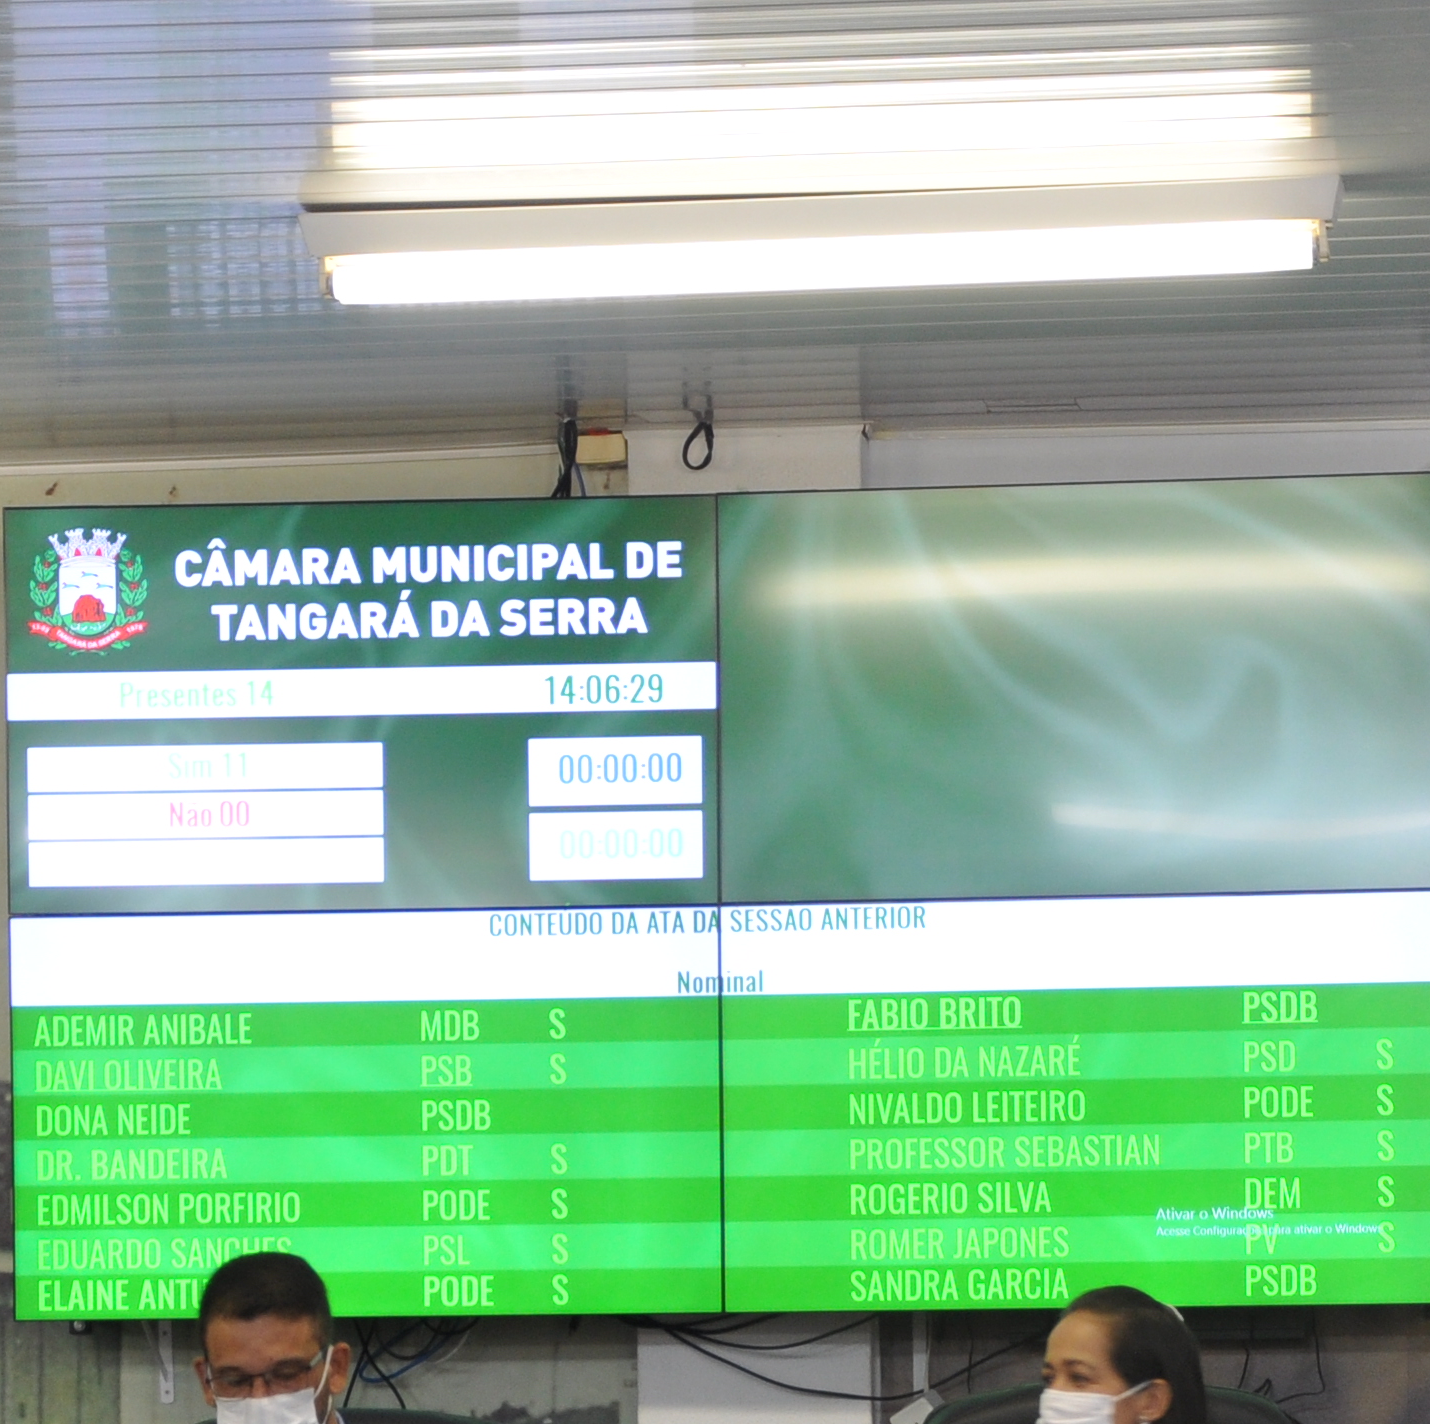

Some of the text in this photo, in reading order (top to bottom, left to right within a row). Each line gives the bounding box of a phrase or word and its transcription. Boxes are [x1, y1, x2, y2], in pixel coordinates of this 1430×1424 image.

[174, 537, 683, 588] CÂMARA MUNICIPAL DE
[211, 590, 648, 642] TANGARÁ DA SERRA
[120, 680, 274, 709] Presentes 14
[545, 674, 664, 706] 14:06:29
[169, 752, 247, 778] Sim 11
[558, 752, 683, 785] 00:00:00
[220, 800, 249, 827] 00
[559, 828, 683, 861] 00:00:00
[612, 911, 639, 935] DA
[647, 910, 684, 934] ATA
[693, 910, 720, 934] DA
[821, 906, 926, 931] ANTERIOR
[677, 970, 764, 994] Nominal
[847, 995, 1022, 1030] FABIO BRITO
[1243, 990, 1318, 1024] PSDB
[34, 1012, 252, 1047] ADEMIR ANIBALE
[420, 1009, 480, 1042] MDB
[549, 1008, 566, 1040] S
[549, 1053, 567, 1085] S
[849, 1035, 1081, 1080] HÉLIO DA NAZARÉ
[1243, 1041, 1297, 1073] PSD
[1376, 1038, 1393, 1070] S
[35, 1057, 222, 1092] DAVI OLIVEIRA
[421, 1055, 473, 1087] PSB
[421, 1099, 492, 1132] PSDB
[849, 1089, 1086, 1126] NIVALDO LEITEIRO
[1244, 1085, 1314, 1119] PODE
[1376, 1084, 1394, 1117] S
[35, 1103, 191, 1137] DONA NEIDE
[422, 1144, 474, 1177] PDT
[550, 1143, 568, 1175] S
[850, 1133, 1161, 1170] PROFESSOR SEBASTIAN
[1244, 1131, 1294, 1164] PTB
[1377, 1130, 1394, 1162] S
[36, 1147, 228, 1182] DR. BANDEIRA
[422, 1189, 491, 1222] PODE
[551, 1188, 568, 1220] S
[850, 1180, 1051, 1216] ROGERIO SILVA
[1244, 1177, 1301, 1210] DEM
[1377, 1175, 1394, 1208] S
[37, 1191, 301, 1226] EDMILSON PORFIRIO
[1156, 1206, 1274, 1220] Ativar o Windows
[851, 1225, 1069, 1260] ROMER JAPONES
[1156, 1225, 1191, 1236] Acesse
[1294, 1224, 1322, 1235] ativar
[1325, 1226, 1333, 1235] o
[1245, 1222, 1279, 1255] PV
[1378, 1220, 1395, 1253] S
[37, 1237, 161, 1270] EDUARDO
[423, 1233, 470, 1266] PSL
[552, 1233, 569, 1265] S
[37, 1278, 130, 1312] ELAINE
[423, 1276, 495, 1309] PODE
[552, 1274, 569, 1307] S
[850, 1267, 1069, 1302] SANDRA GARCIA
[1245, 1265, 1318, 1298] PSDB
